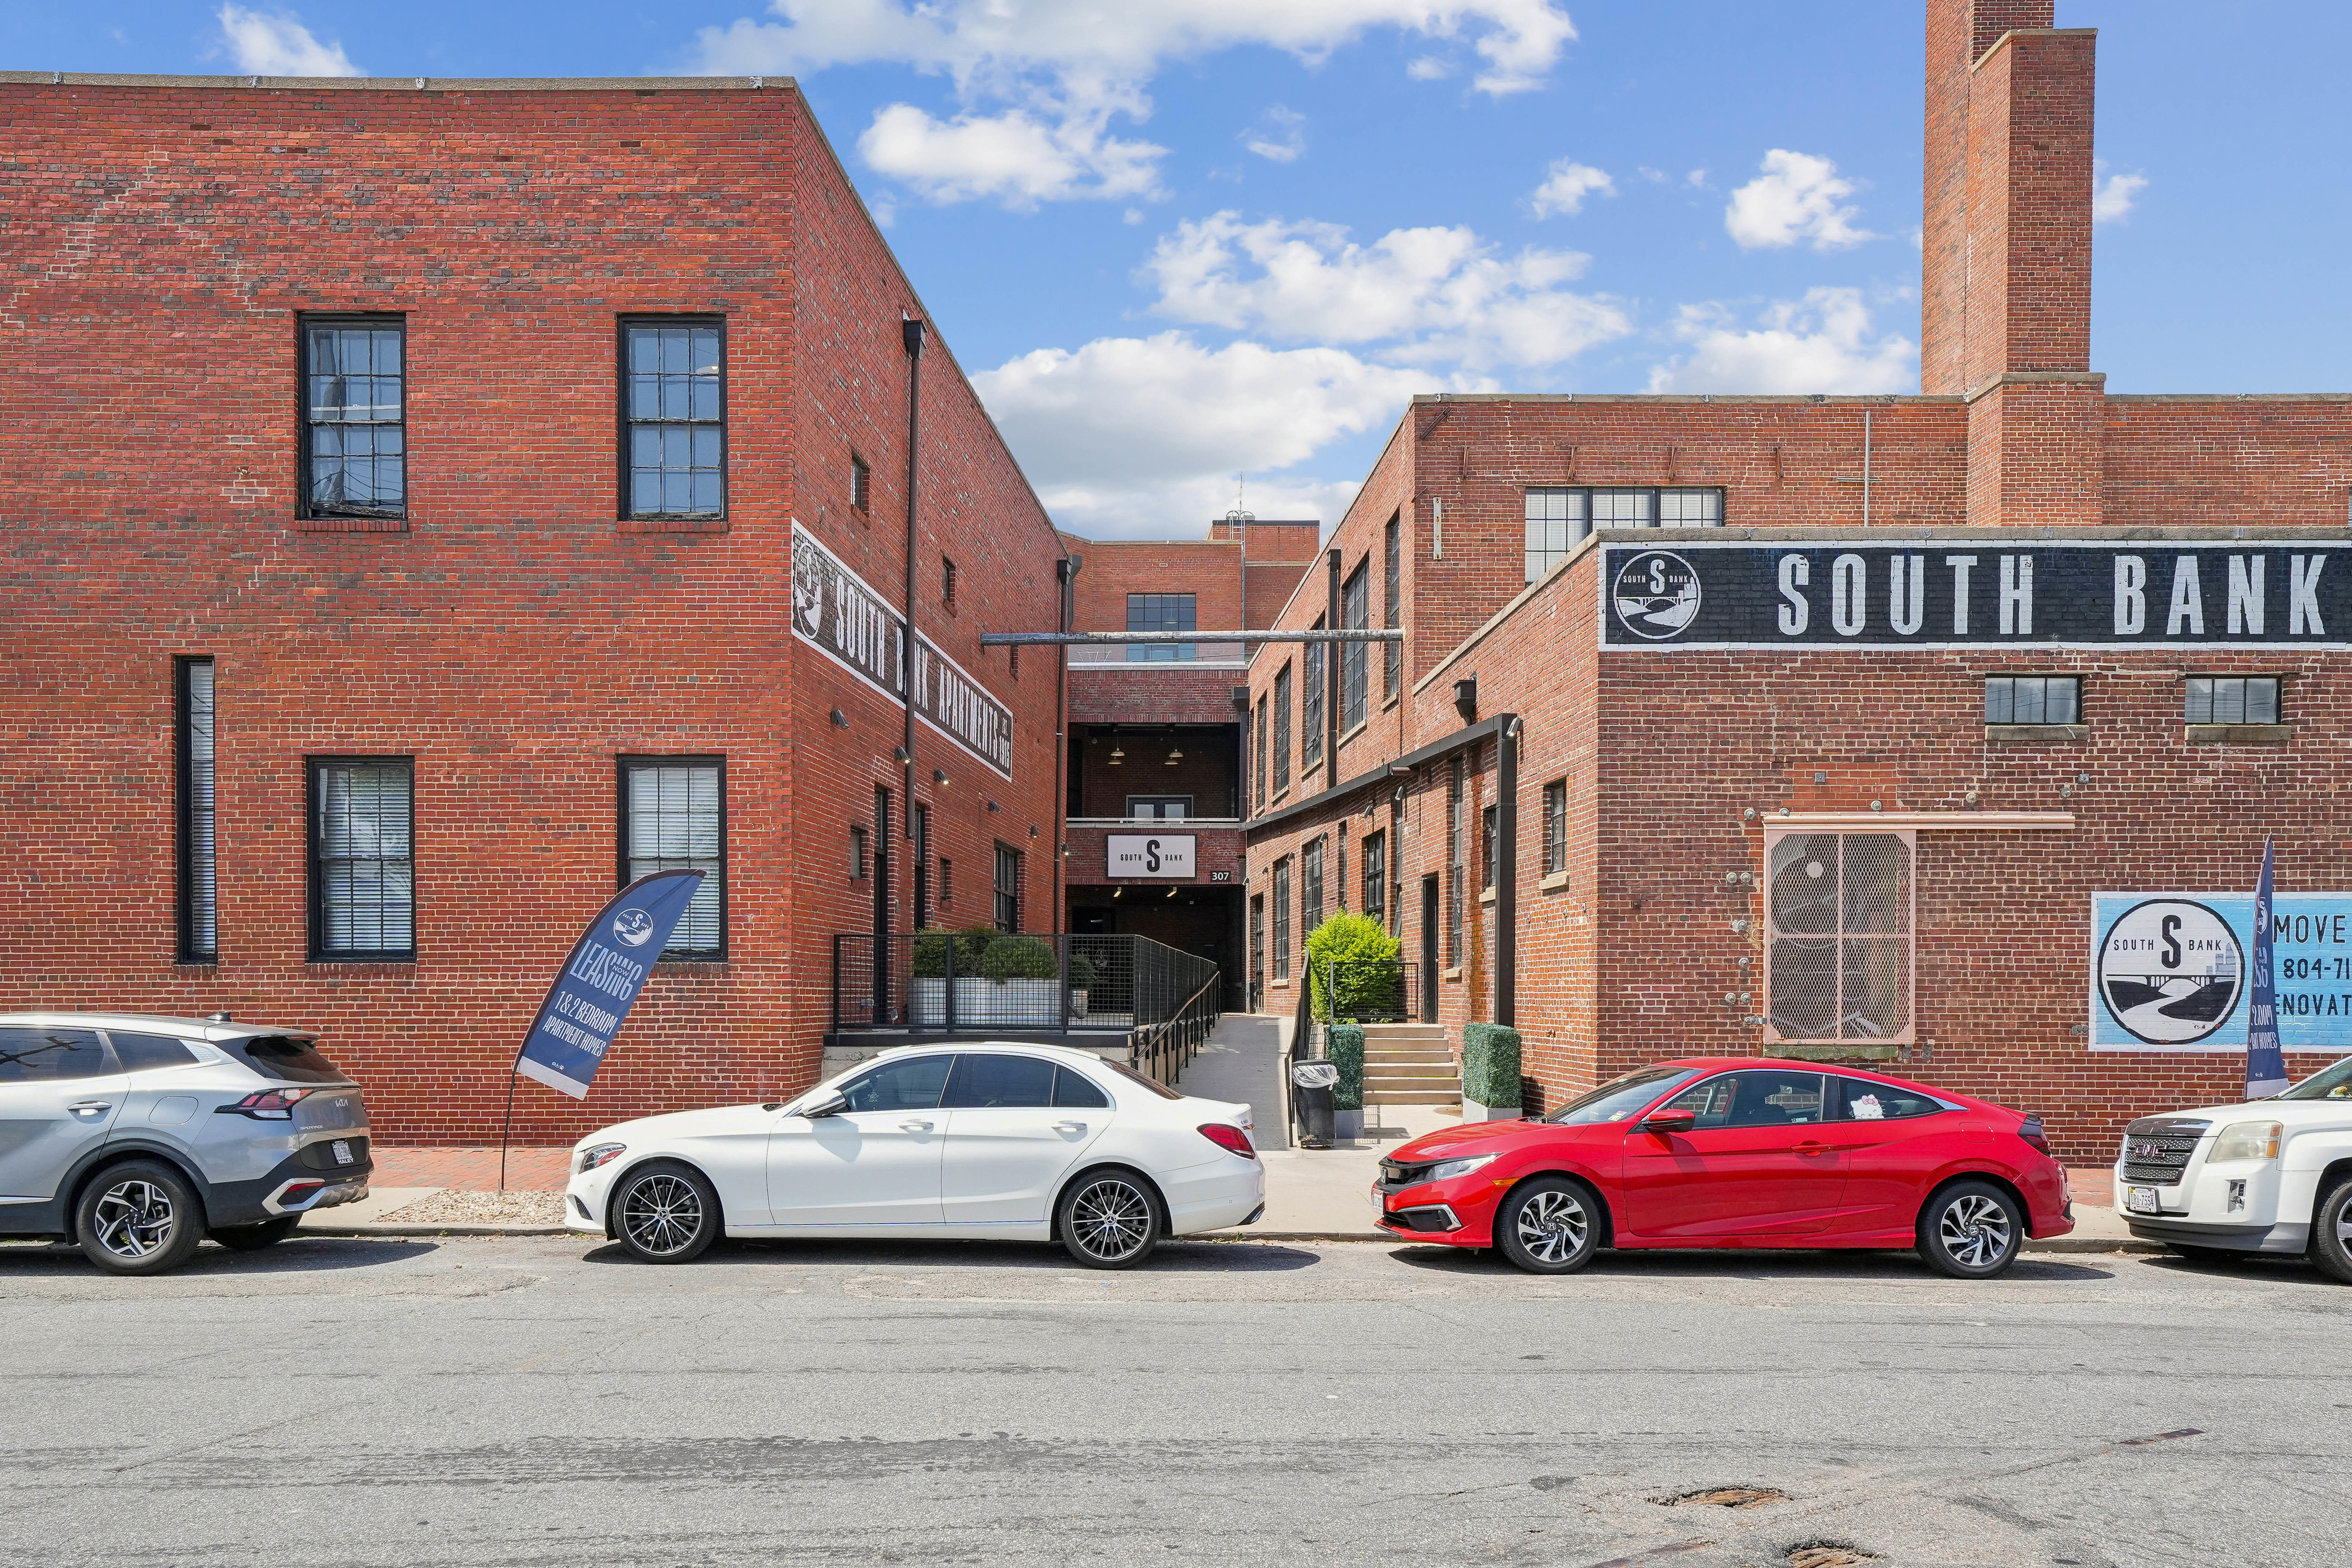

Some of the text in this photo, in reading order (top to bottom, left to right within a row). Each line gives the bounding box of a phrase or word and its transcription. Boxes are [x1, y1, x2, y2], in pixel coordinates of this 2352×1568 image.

[1623, 575, 1646, 583] SOUTH
[1650, 559, 1665, 594] S
[1778, 553, 2327, 635] SOUTH BANK
[836, 575, 998, 760] SOUTH BNK APARTMENTS
[999, 735, 1010, 769] 1915
[1146, 839, 1160, 872] S
[631, 913, 643, 928] S
[2273, 915, 2346, 943] MOVE
[2114, 915, 2222, 969] SOUTH S BANK
[569, 939, 643, 1001] LEASING
[612, 965, 629, 976] NOW
[555, 991, 618, 1035] 1 & 2 BEDROOM
[542, 1015, 607, 1057] APARTMENT HOMES
[2260, 1032, 2278, 1050] HOMES
[335, 1099, 348, 1107] KIA
[2135, 1144, 2166, 1157] GMC
